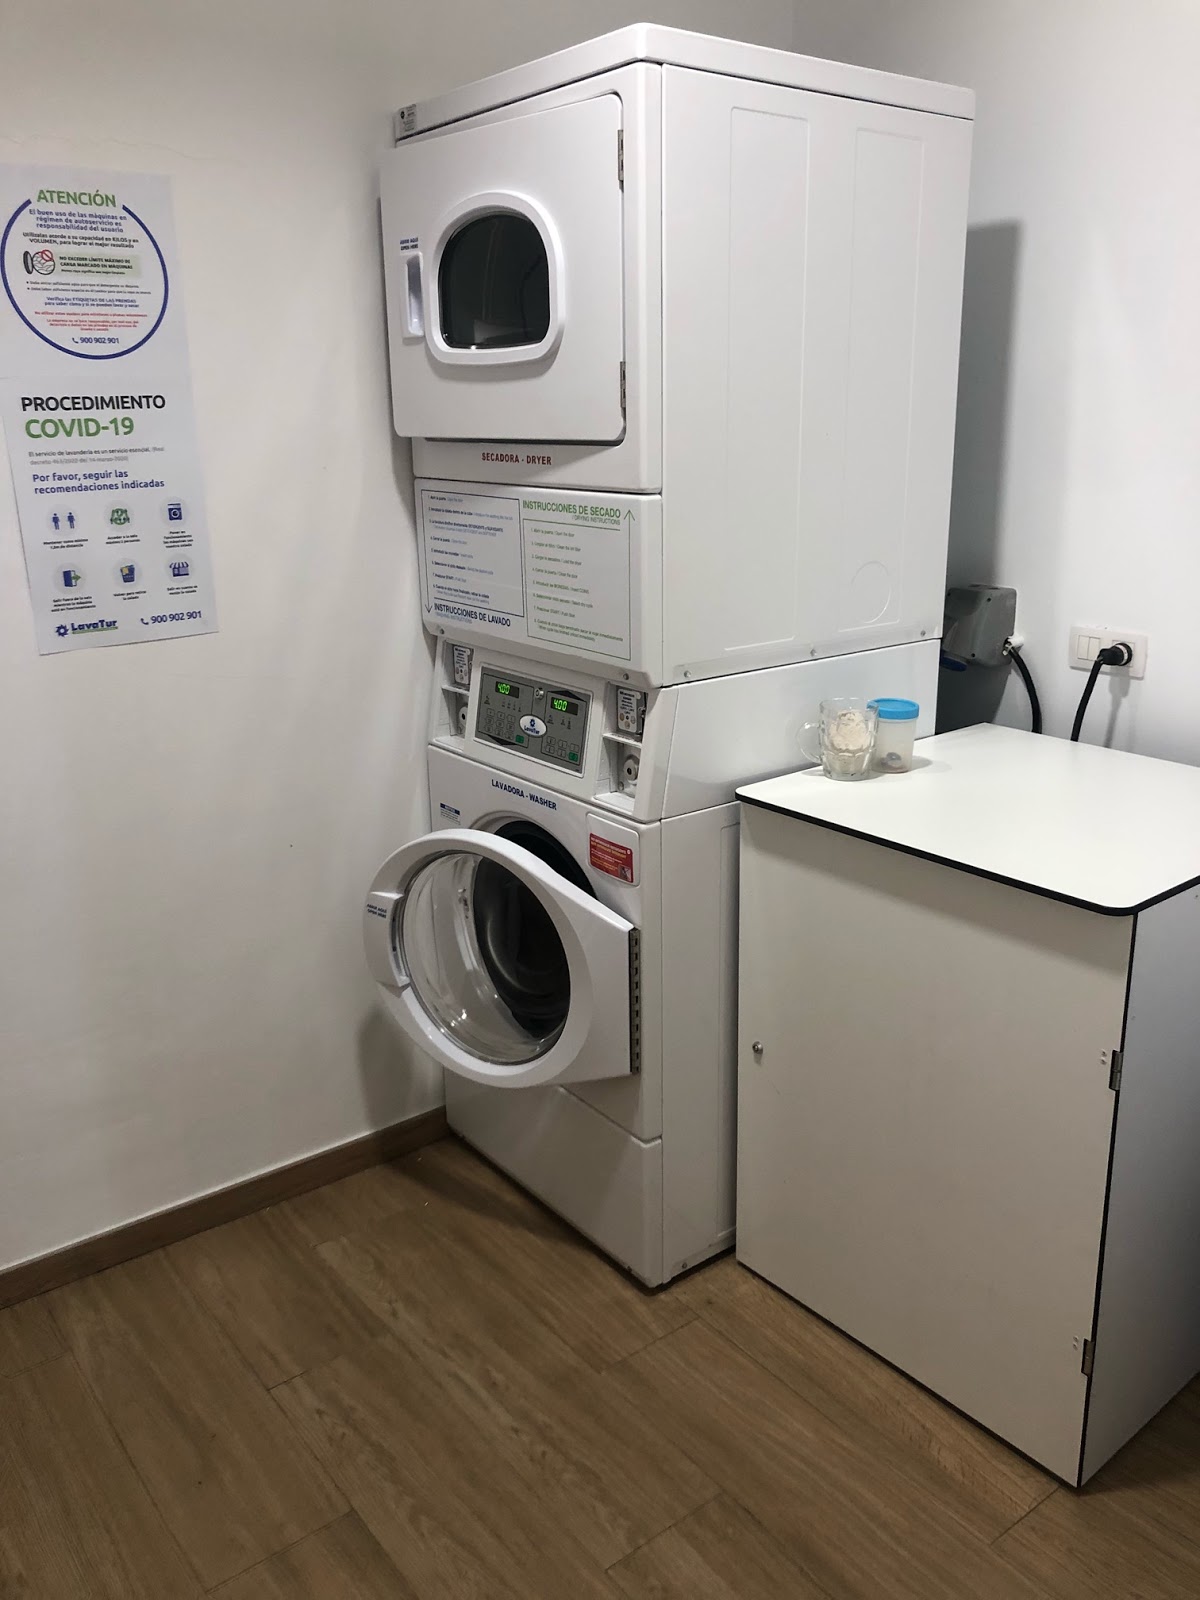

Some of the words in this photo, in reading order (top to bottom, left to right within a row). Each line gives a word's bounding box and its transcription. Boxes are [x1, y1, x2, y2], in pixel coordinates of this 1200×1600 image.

[37, 189, 116, 207] ATENCIÓN
[36, 223, 87, 231] responsabilidad
[21, 395, 165, 411] PROCEDIMIENTO
[25, 417, 134, 438] COVID-19
[482, 452, 519, 463] SECADORA
[527, 455, 551, 465] DRYER
[33, 474, 49, 482] Por
[52, 472, 81, 482] favor,
[83, 470, 112, 481] seguir
[115, 470, 128, 478] las
[35, 483, 119, 494] recomendaciones
[121, 479, 165, 489] indicadas
[523, 500, 577, 514] INSTRUCCIONES
[578, 505, 588, 515] DE
[590, 506, 621, 518] SECADO
[151, 615, 167, 624] 900
[169, 613, 184, 622] 902
[186, 610, 202, 620] 901
[434, 603, 478, 620] INSTRUCCIONES
[479, 612, 487, 622] DE
[488, 614, 511, 627] LAVADO
[71, 619, 117, 631] LavaTur
[492, 779, 524, 798] LAVADORA
[529, 793, 556, 810] WASHER
